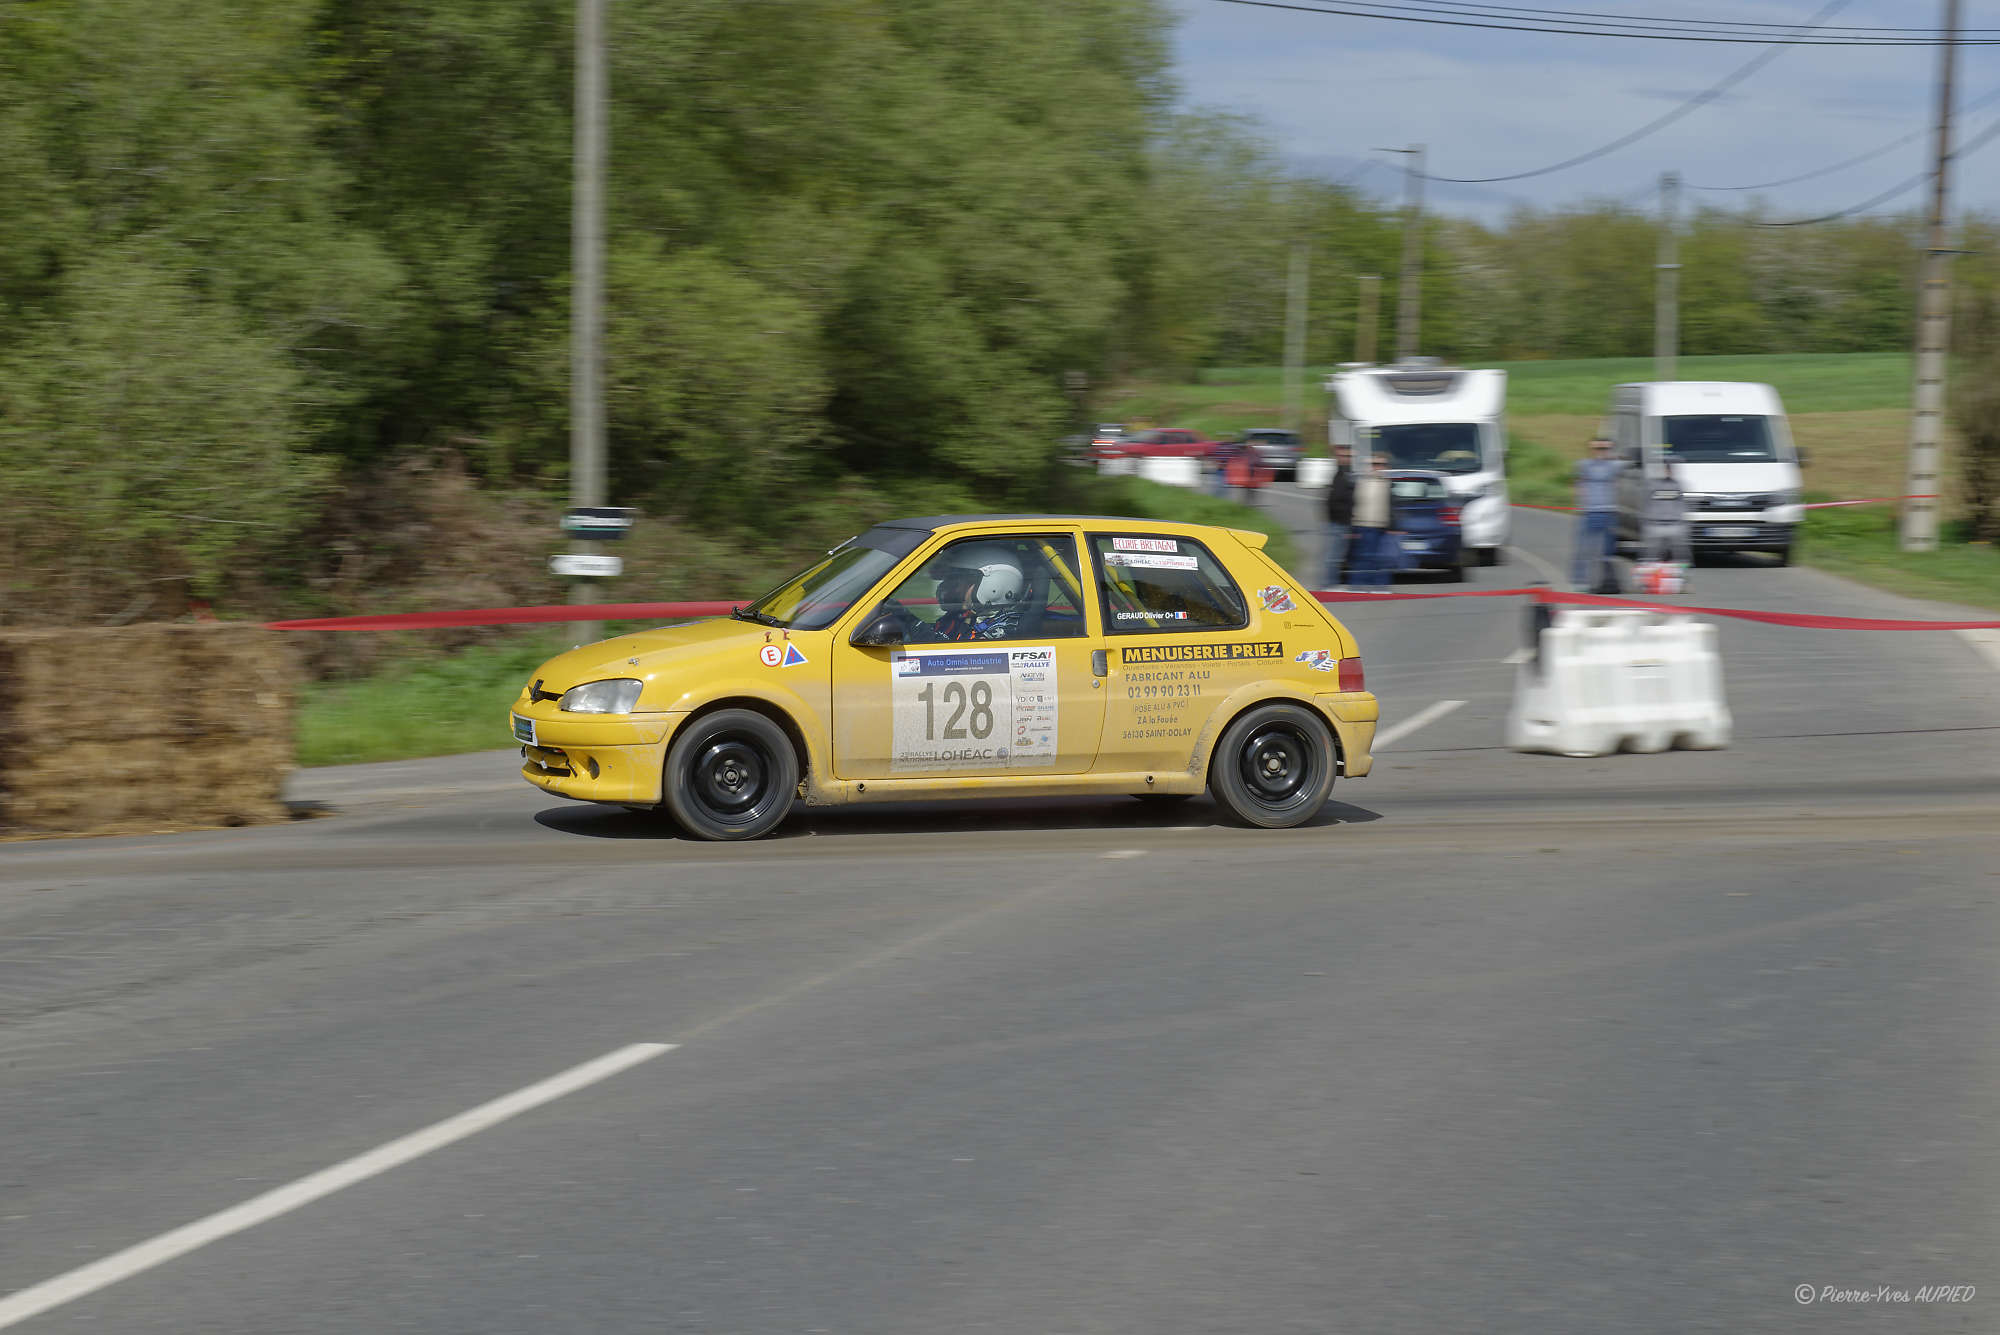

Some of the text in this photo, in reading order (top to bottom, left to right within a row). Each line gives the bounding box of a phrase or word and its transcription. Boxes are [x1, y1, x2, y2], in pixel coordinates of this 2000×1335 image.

[1114, 539, 1176, 551] ECURIE BRETAGNE
[1117, 612, 1143, 620] GERAUD
[1144, 611, 1164, 619] Olivier
[767, 649, 776, 661] E
[1012, 652, 1048, 660] FFSA
[1125, 643, 1281, 662] MENUISERIE PRIEZ
[927, 659, 945, 667] Auto
[946, 658, 968, 666] Omnia
[970, 657, 1002, 665] Industrie
[1125, 671, 1211, 682] FABRICANT ALU
[1128, 684, 1201, 698] 02 99 90 23 11
[917, 680, 994, 741] 128
[1137, 715, 1147, 725] ZA
[1145, 728, 1192, 738] SAINT-DOLAY
[934, 747, 993, 761] LOHÉAC
